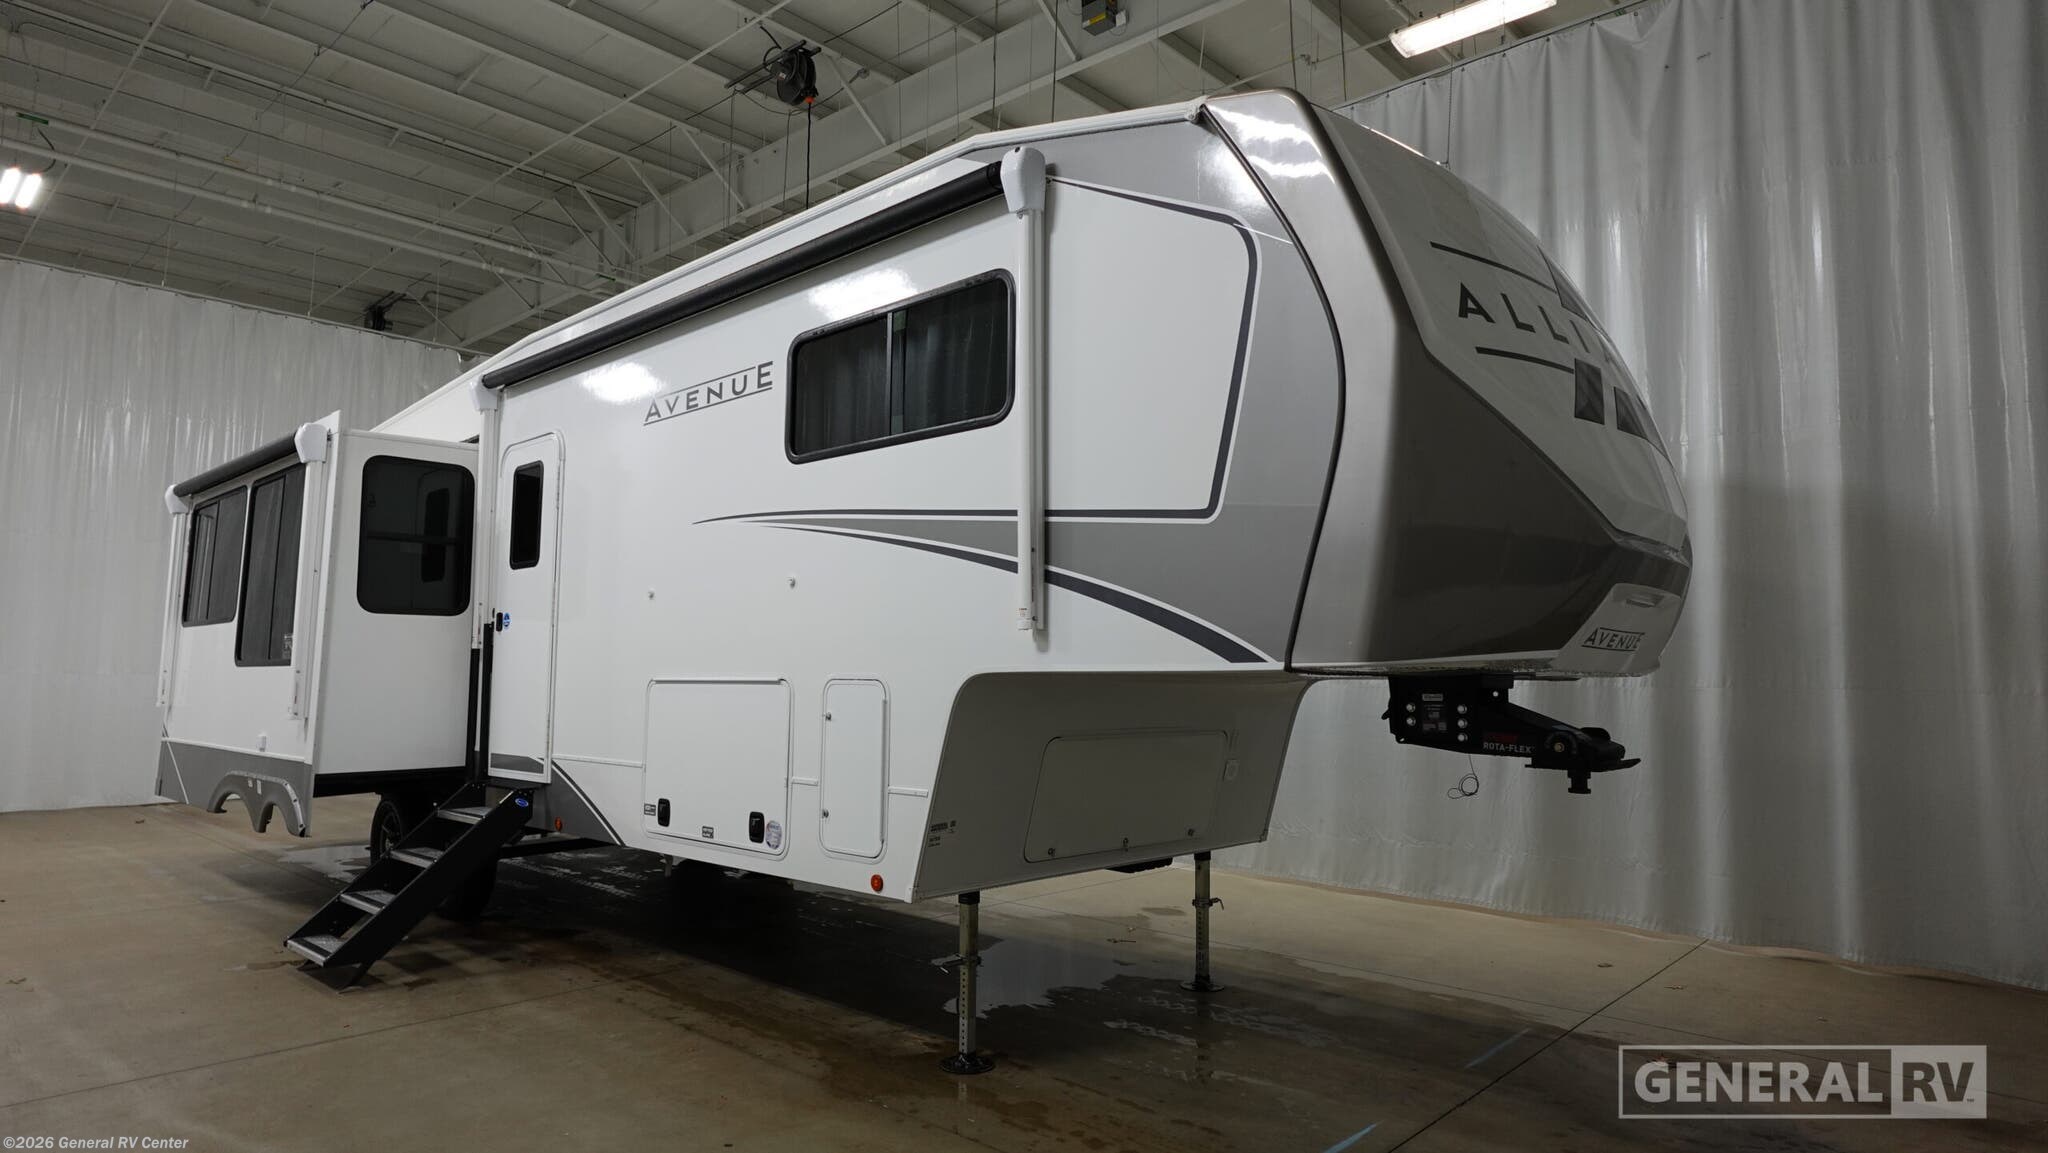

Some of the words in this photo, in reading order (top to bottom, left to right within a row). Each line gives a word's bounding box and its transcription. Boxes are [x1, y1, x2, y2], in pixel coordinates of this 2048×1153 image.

[644, 360, 774, 423] AVENUE
[1583, 627, 1646, 650] AVENUE
[1482, 741, 1533, 754] ROTA-FLEX
